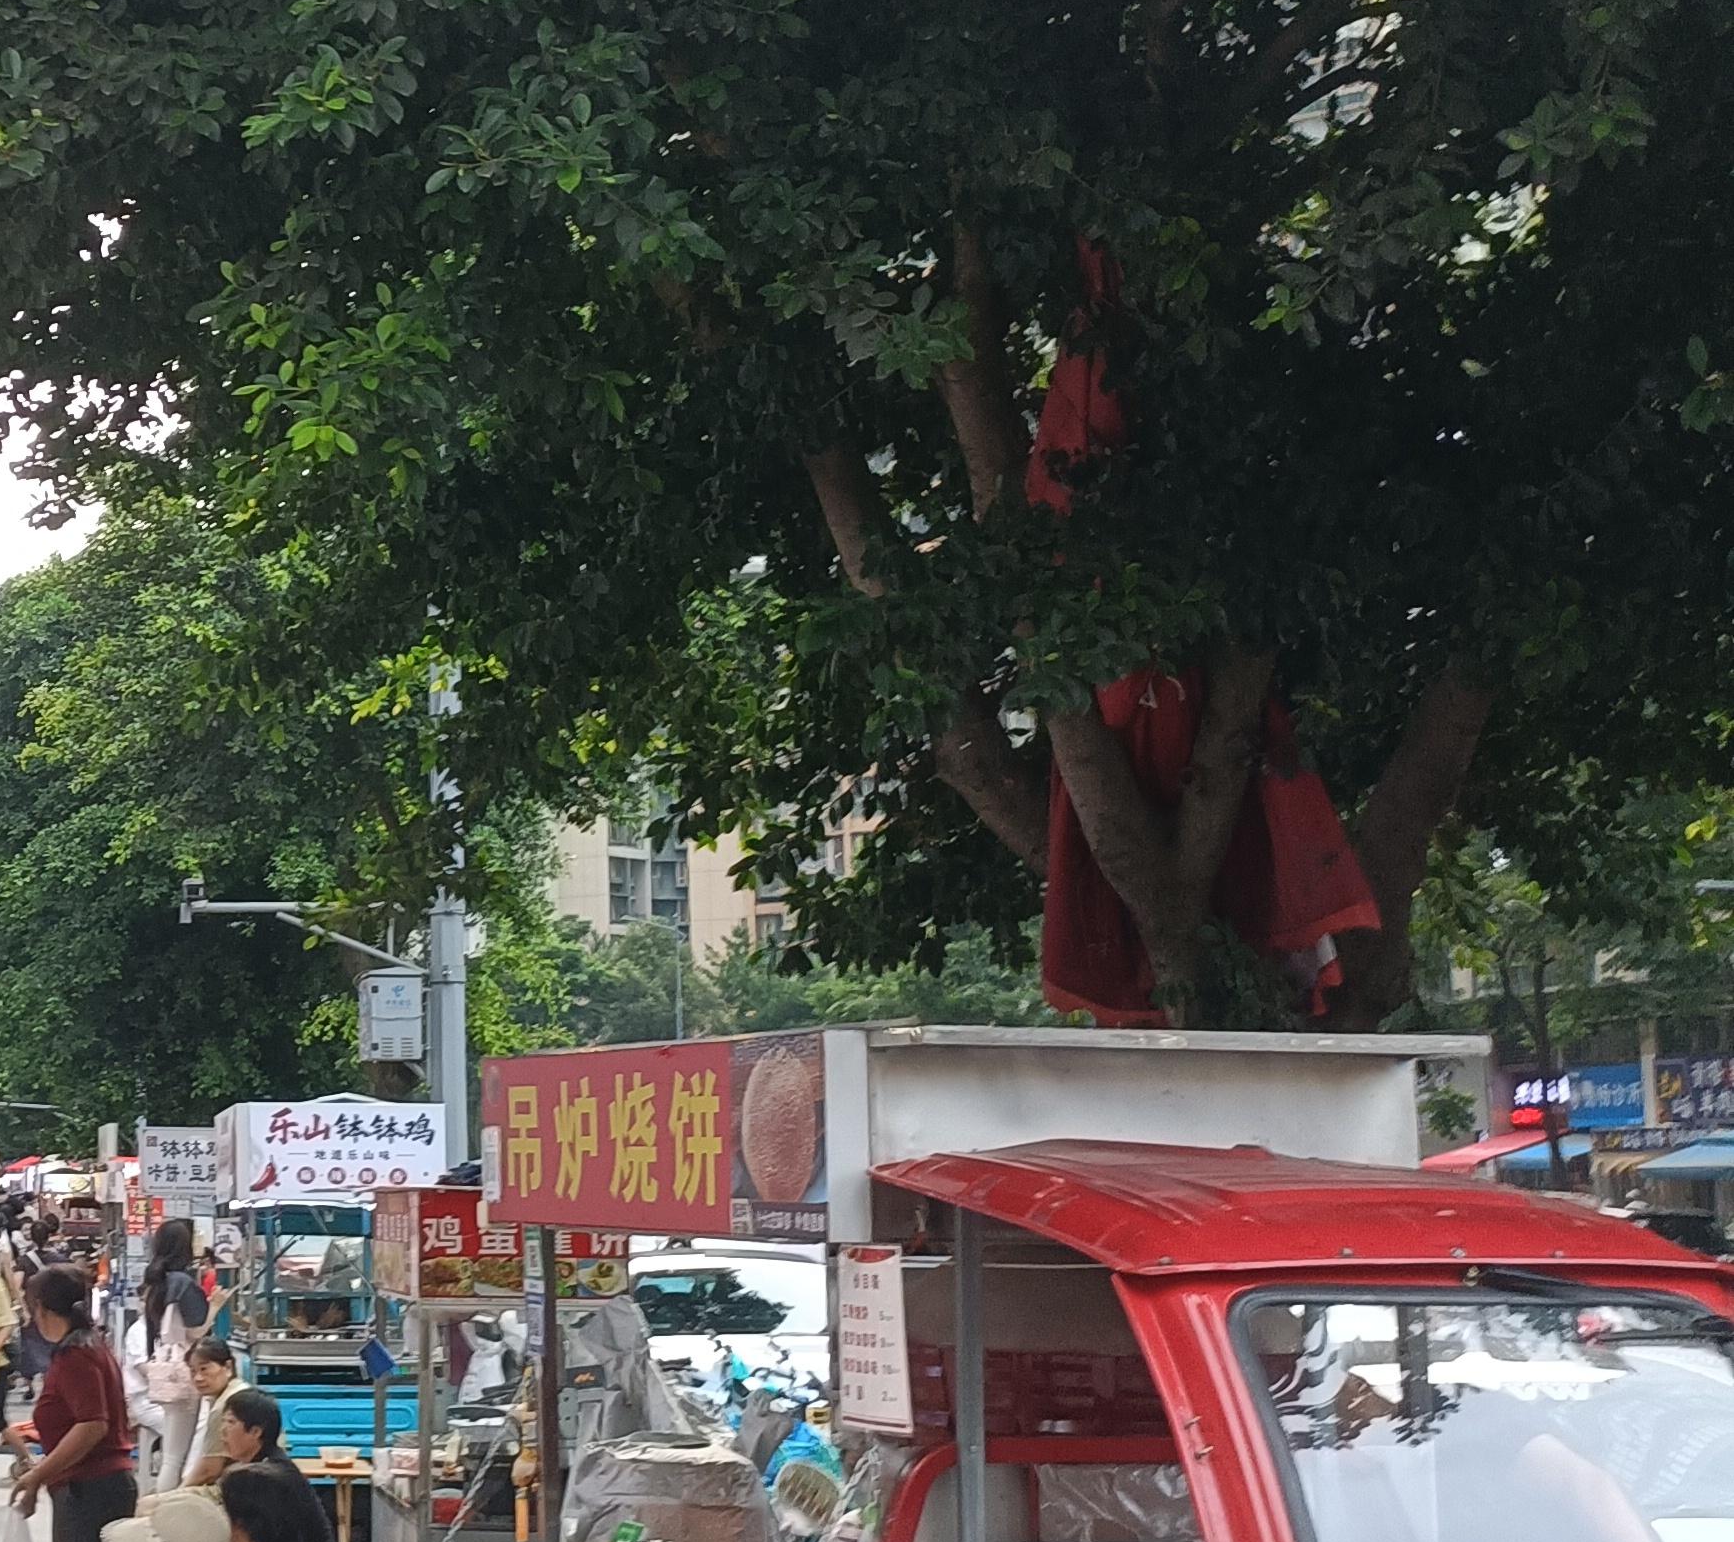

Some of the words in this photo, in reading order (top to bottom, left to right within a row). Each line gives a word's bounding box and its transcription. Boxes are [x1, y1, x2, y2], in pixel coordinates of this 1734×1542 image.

[266, 1108, 436, 1146] 乐山钵钵鸡
[507, 1069, 723, 1207] 吊炉烧饼
